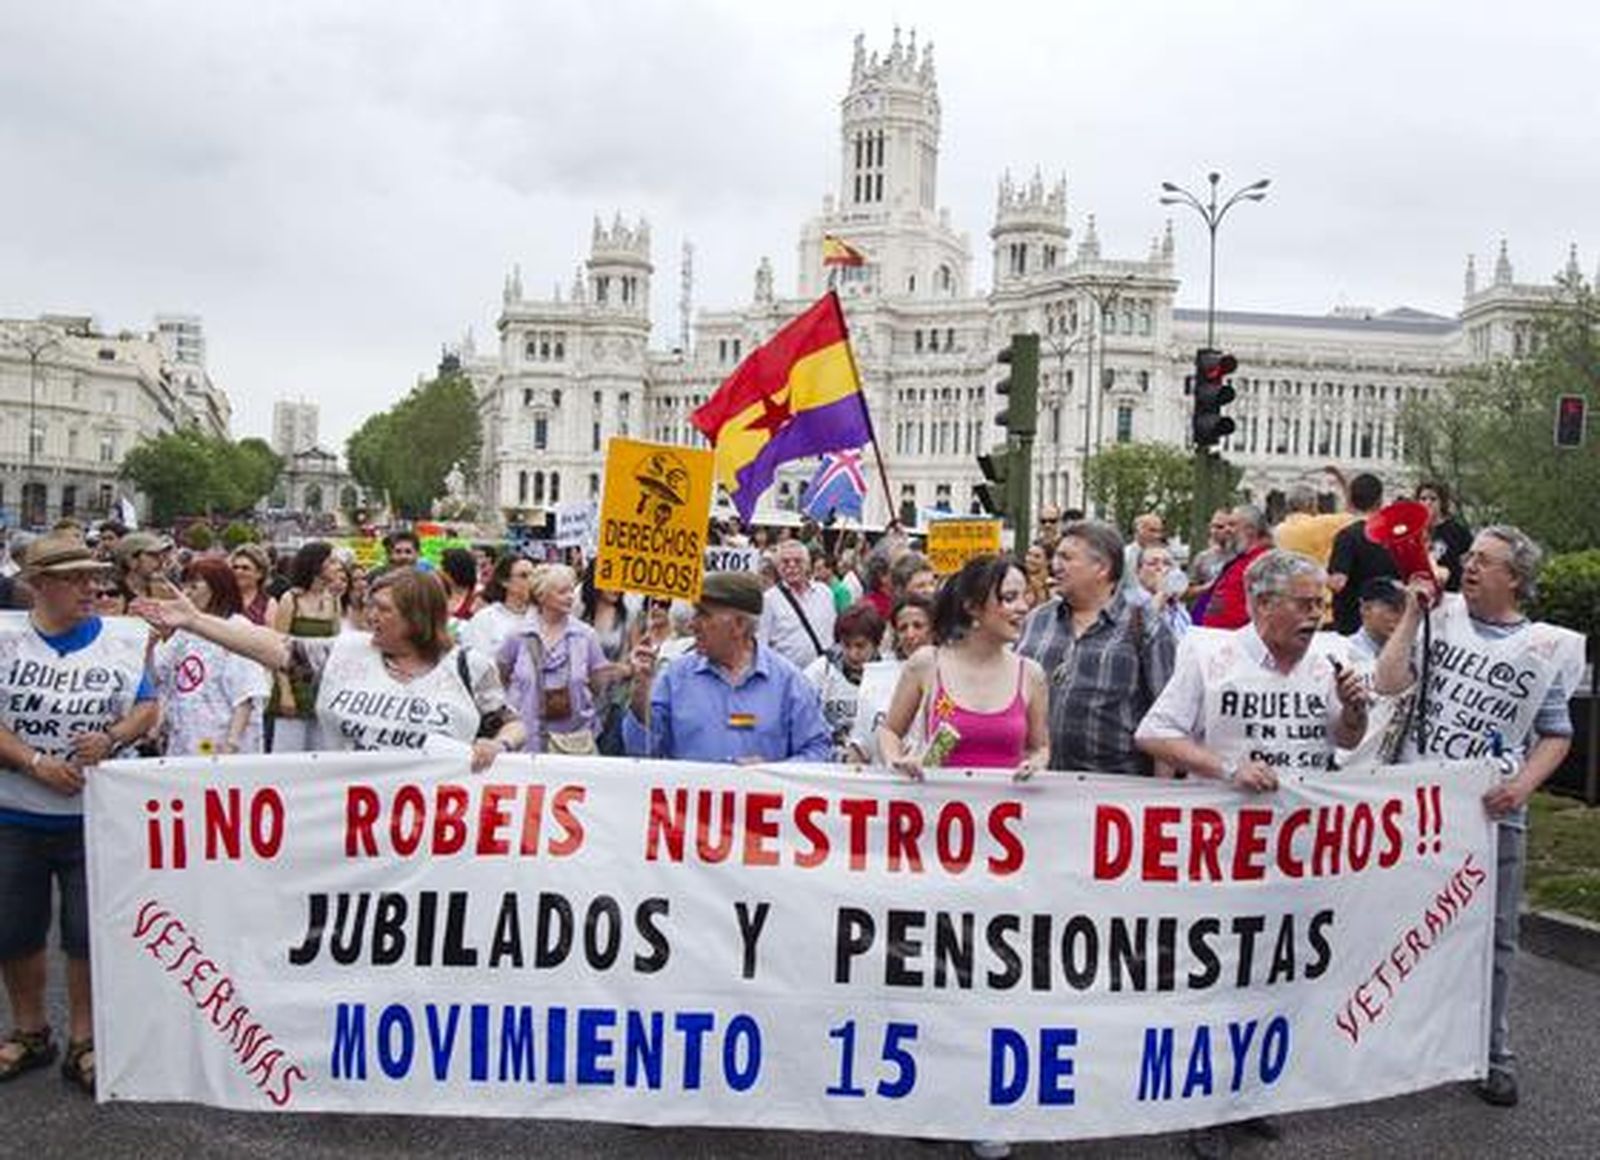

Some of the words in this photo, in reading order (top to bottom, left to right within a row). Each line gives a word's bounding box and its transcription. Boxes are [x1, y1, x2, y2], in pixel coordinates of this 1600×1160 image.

[604, 518, 699, 560] DERECHOS
[600, 560, 613, 580] a
[620, 554, 699, 596] TODOS!
[1427, 638, 1537, 699] BUEL@S
[9, 694, 43, 712] EN
[328, 689, 450, 726] ABUEL@S
[1220, 690, 1327, 719] ABUEL@
[1450, 683, 1520, 724] LUCHA
[1451, 710, 1499, 738] SUS
[14, 720, 60, 738] POR
[340, 719, 367, 738] EN
[344, 783, 588, 859] ROBEIS
[645, 786, 1026, 877] NUESTROS
[288, 891, 670, 974] JUBILADOS
[734, 902, 770, 979] Y
[834, 907, 1335, 993] PENSIONISTAS
[1335, 854, 1488, 1045] VETERANOS
[131, 899, 307, 1107] VETERANAS
[330, 1003, 764, 1093] MOVIMIENTO
[826, 1020, 918, 1100] 15
[988, 1026, 1079, 1107] DE
[1138, 1014, 1292, 1102] MAYO
